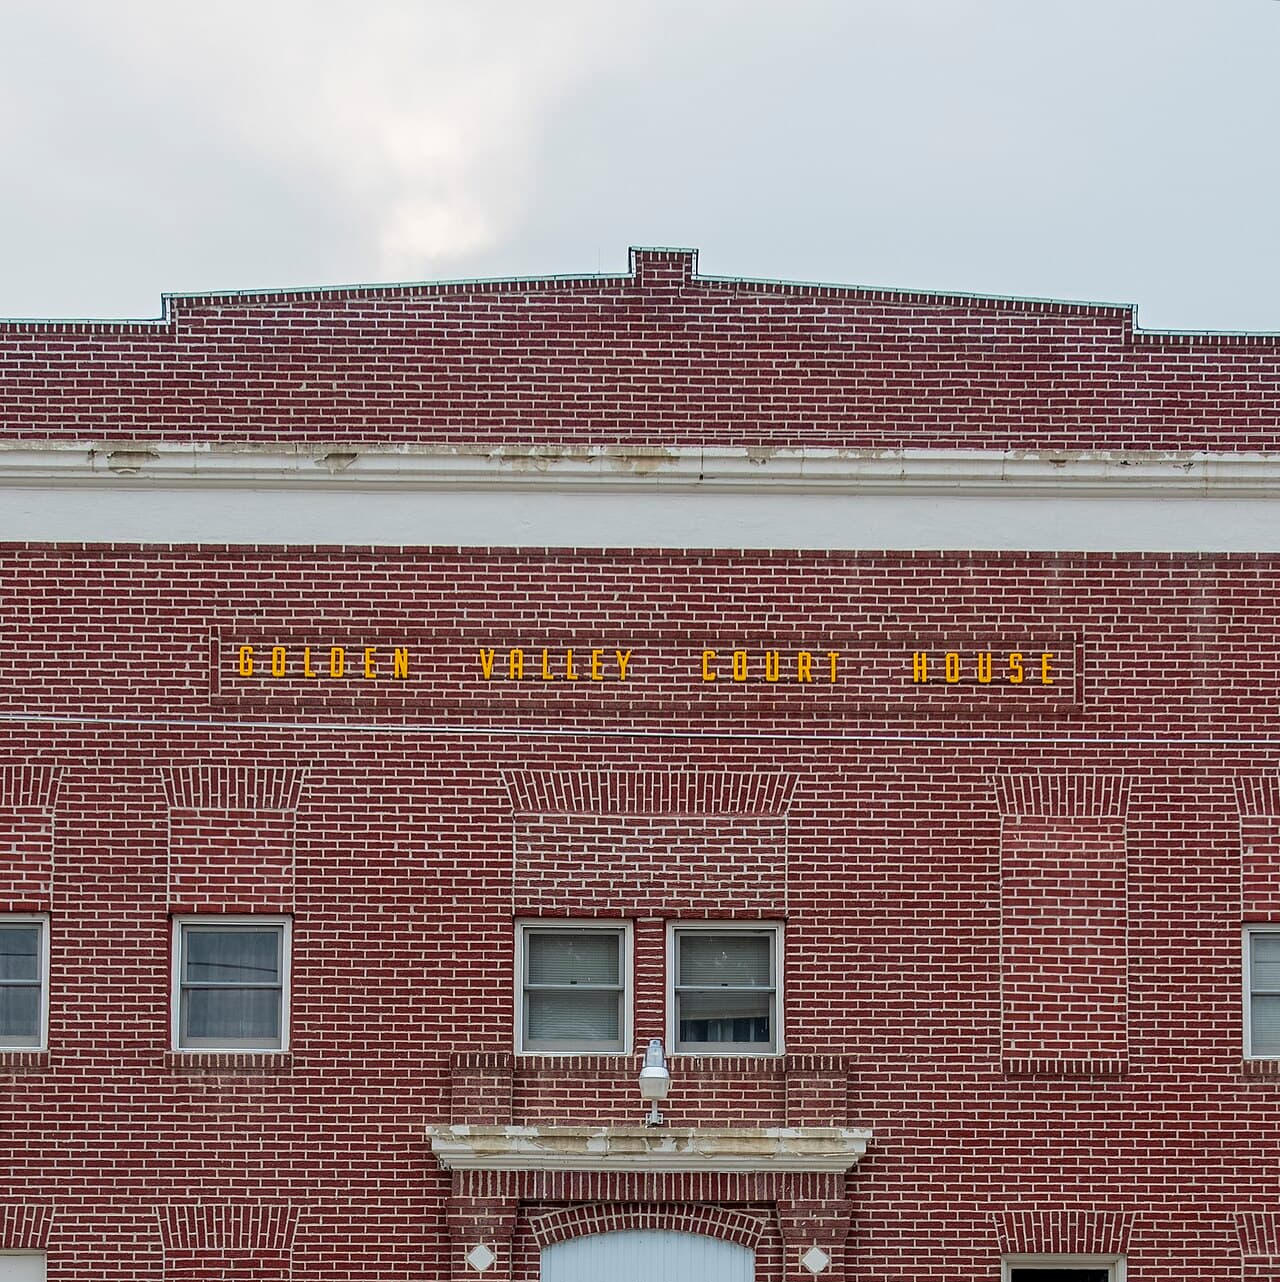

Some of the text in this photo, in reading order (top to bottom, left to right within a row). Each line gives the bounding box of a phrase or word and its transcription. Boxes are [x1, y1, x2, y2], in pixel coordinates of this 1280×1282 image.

[237, 644, 1055, 686] GOLDEN VALLEY COURT HOUSE
